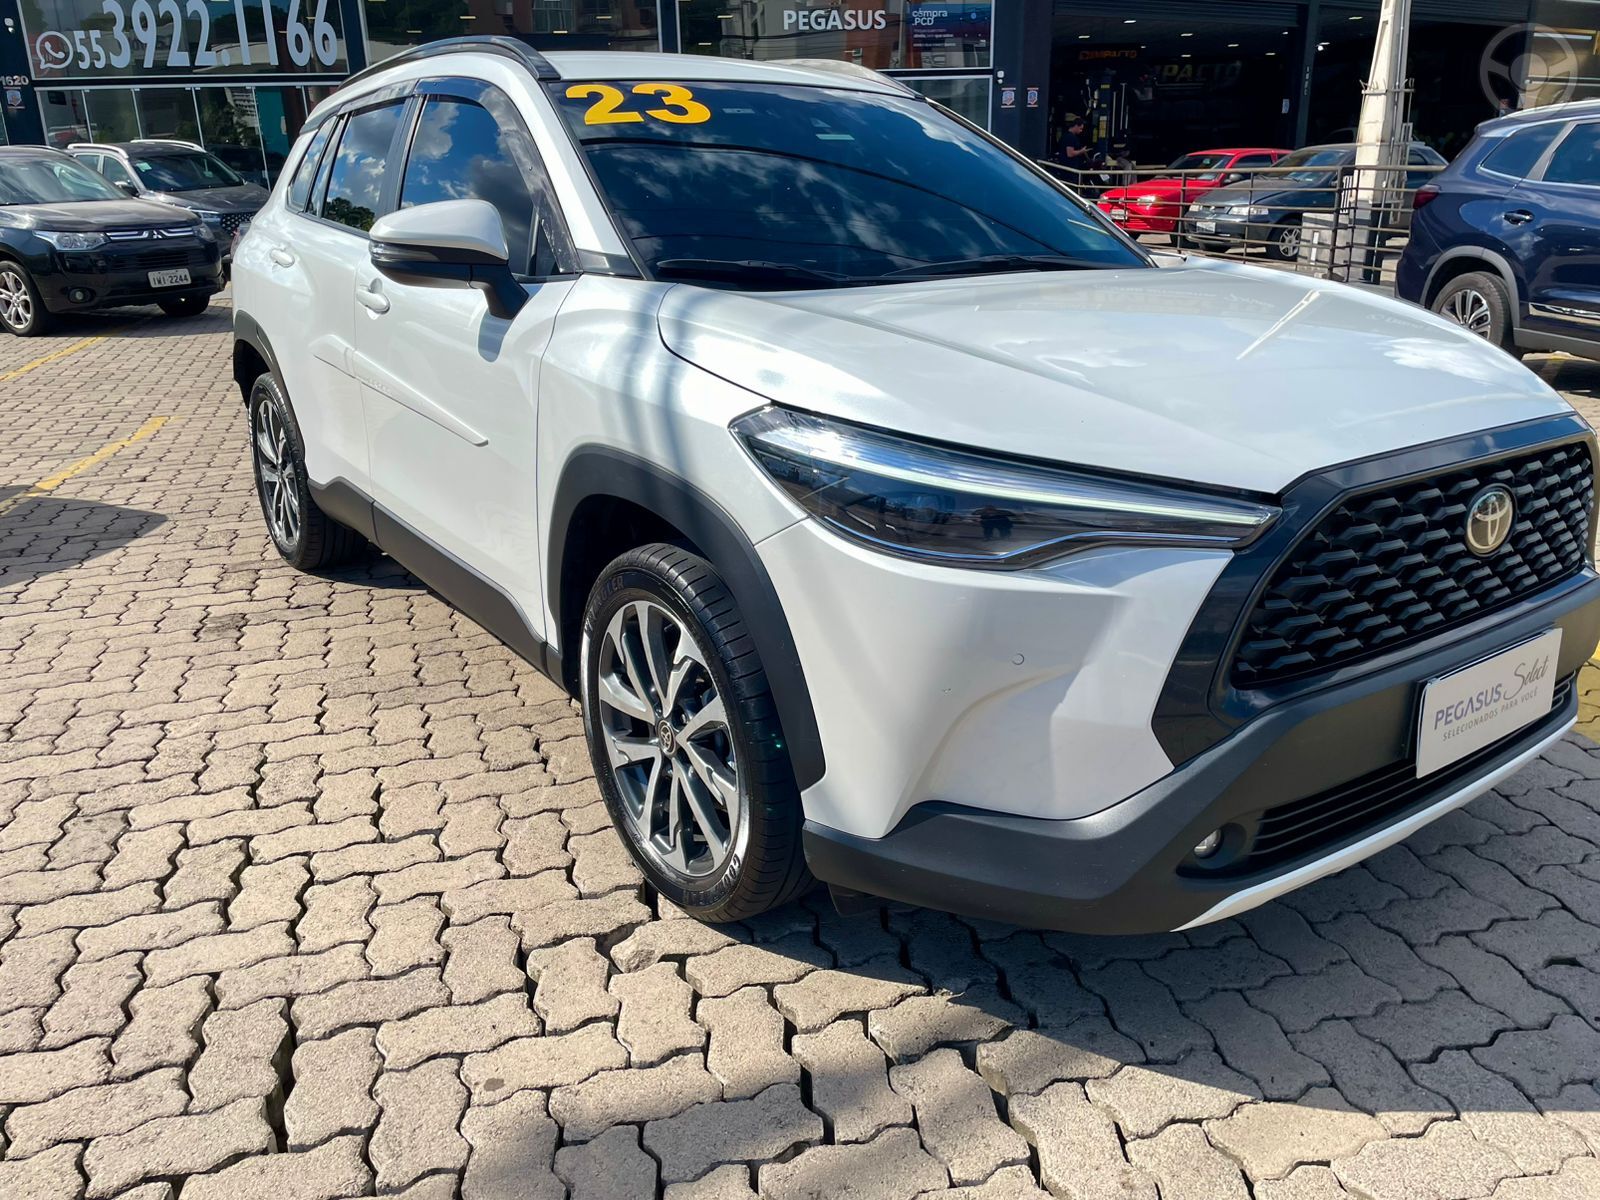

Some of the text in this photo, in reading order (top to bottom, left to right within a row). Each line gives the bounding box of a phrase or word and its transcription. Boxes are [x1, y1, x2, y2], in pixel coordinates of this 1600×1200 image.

[783, 9, 887, 31] PEGASUS
[73, 29, 107, 70] 55
[0, 75, 29, 86] 1620
[565, 83, 711, 125] 23
[1433, 655, 1549, 731] PEGASUS Select
[1442, 707, 1498, 742] SELECIONADOS
[1500, 698, 1518, 713] PARA
